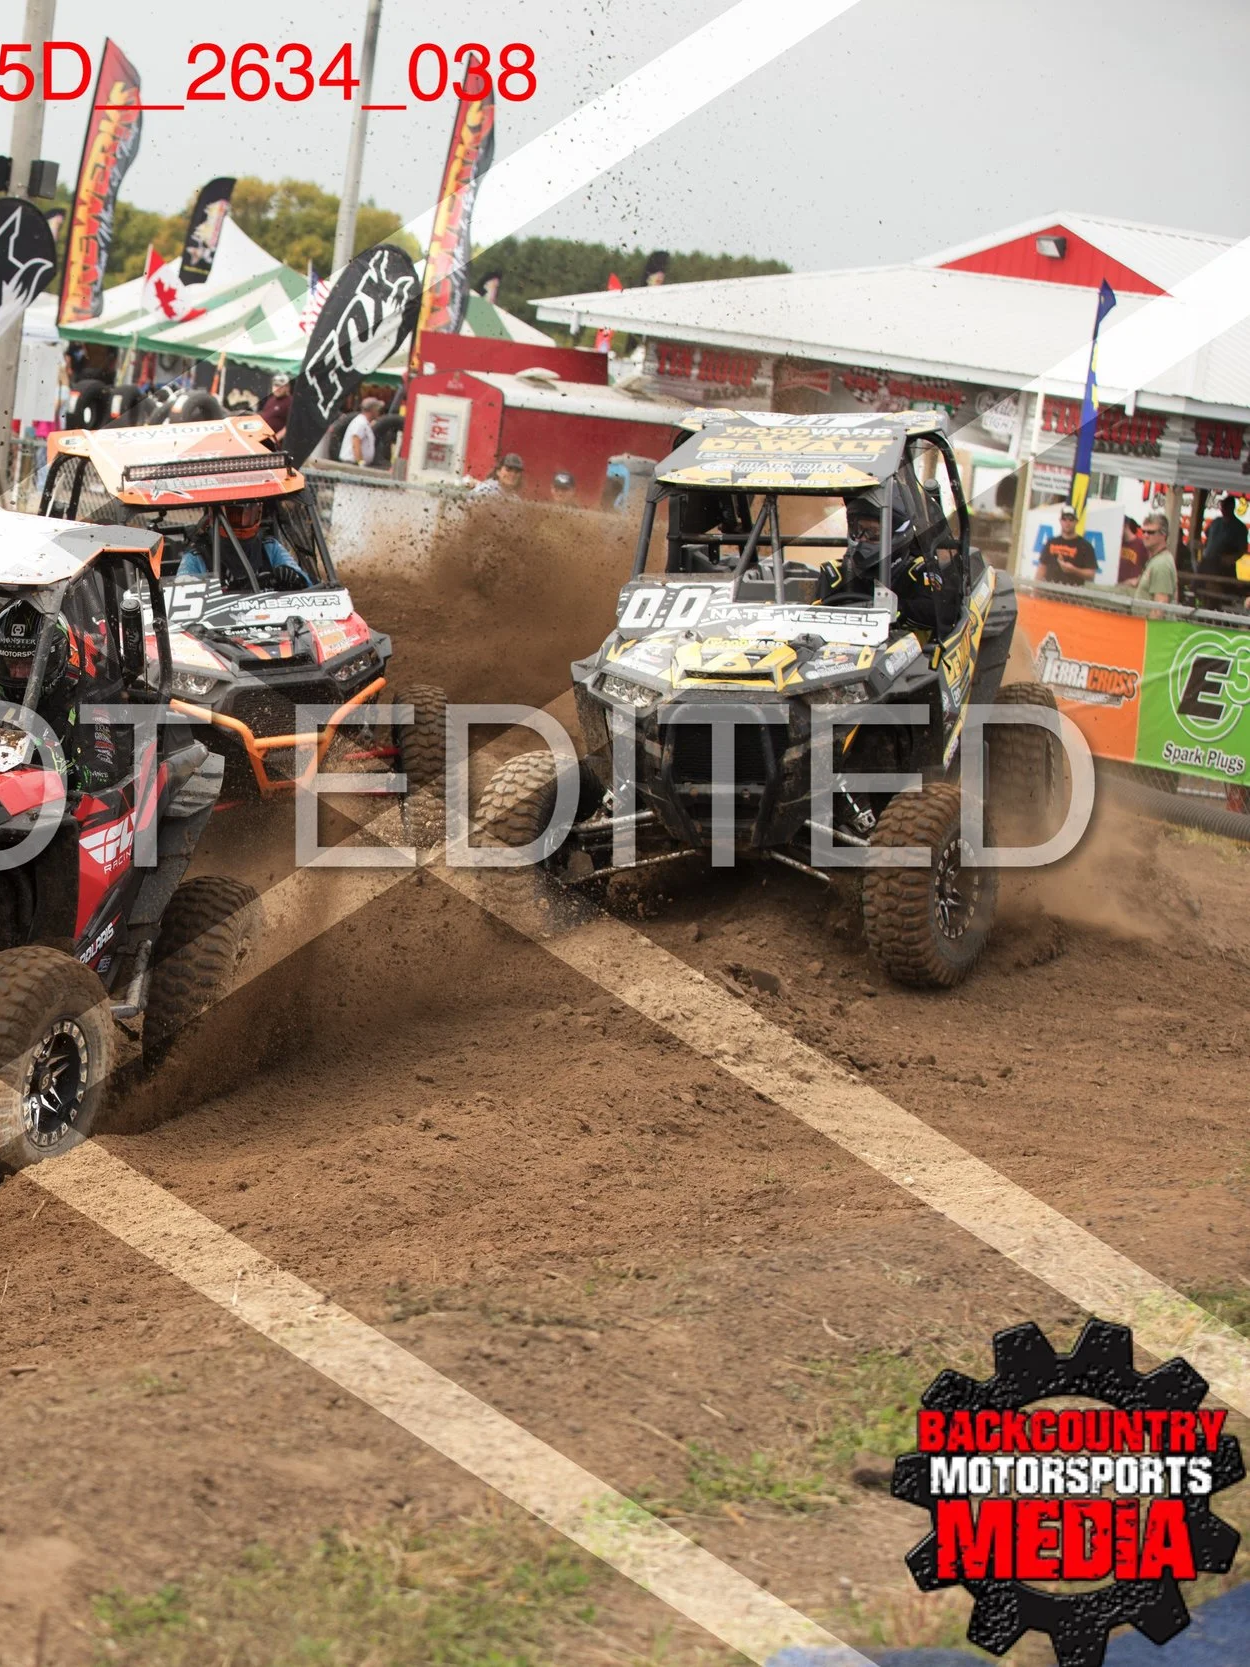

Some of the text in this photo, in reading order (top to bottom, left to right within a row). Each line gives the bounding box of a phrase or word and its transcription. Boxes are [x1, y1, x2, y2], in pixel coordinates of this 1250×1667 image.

[303, 249, 415, 420] FOX
[724, 426, 893, 437] WOODWARD
[697, 437, 895, 455] DEWALT
[264, 594, 342, 610] BEAVER
[710, 608, 878, 627] NATE WESSEL
[0, 638, 37, 646] MONSTER
[1041, 650, 1138, 699] TERRACROSS
[1163, 741, 1246, 776] Spark Plugs
